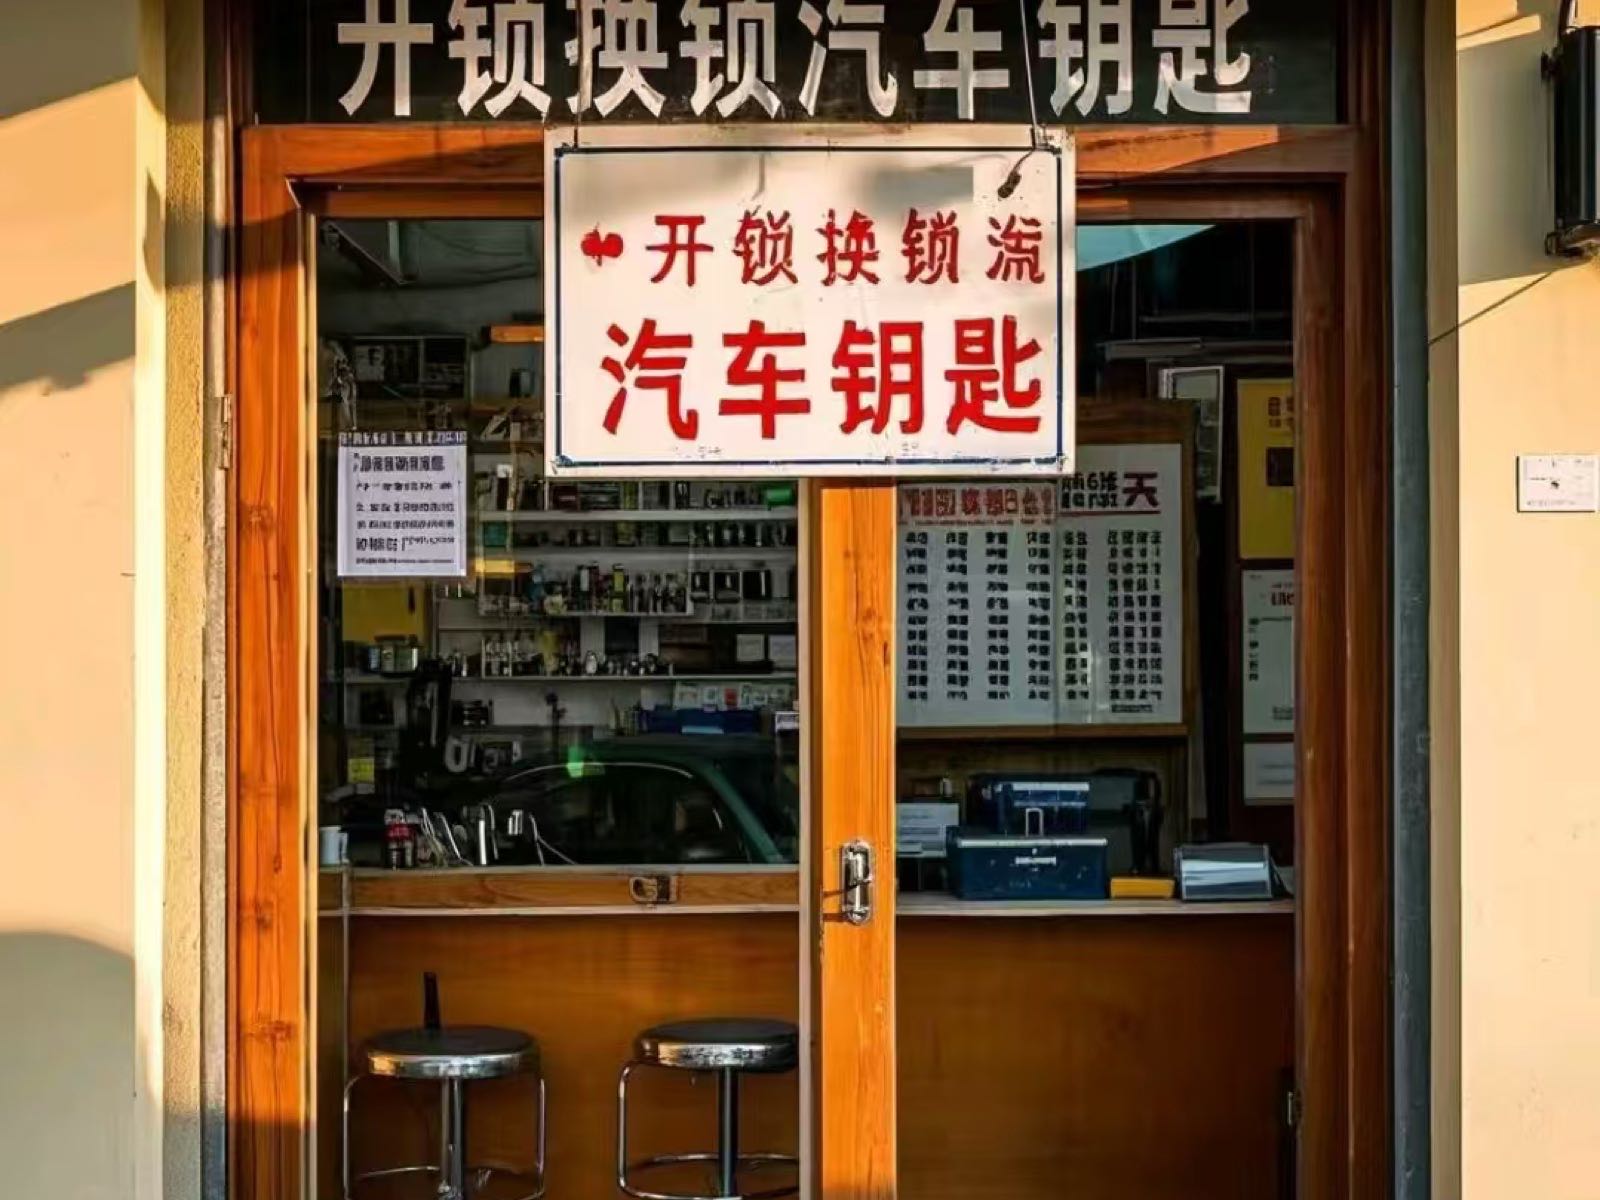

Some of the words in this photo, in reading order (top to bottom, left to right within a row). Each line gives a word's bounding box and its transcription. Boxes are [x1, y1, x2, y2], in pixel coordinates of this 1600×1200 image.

[337, 0, 1253, 119] 开锁换锁汽车钥匙
[600, 314, 1043, 440] 汽车钥匙
